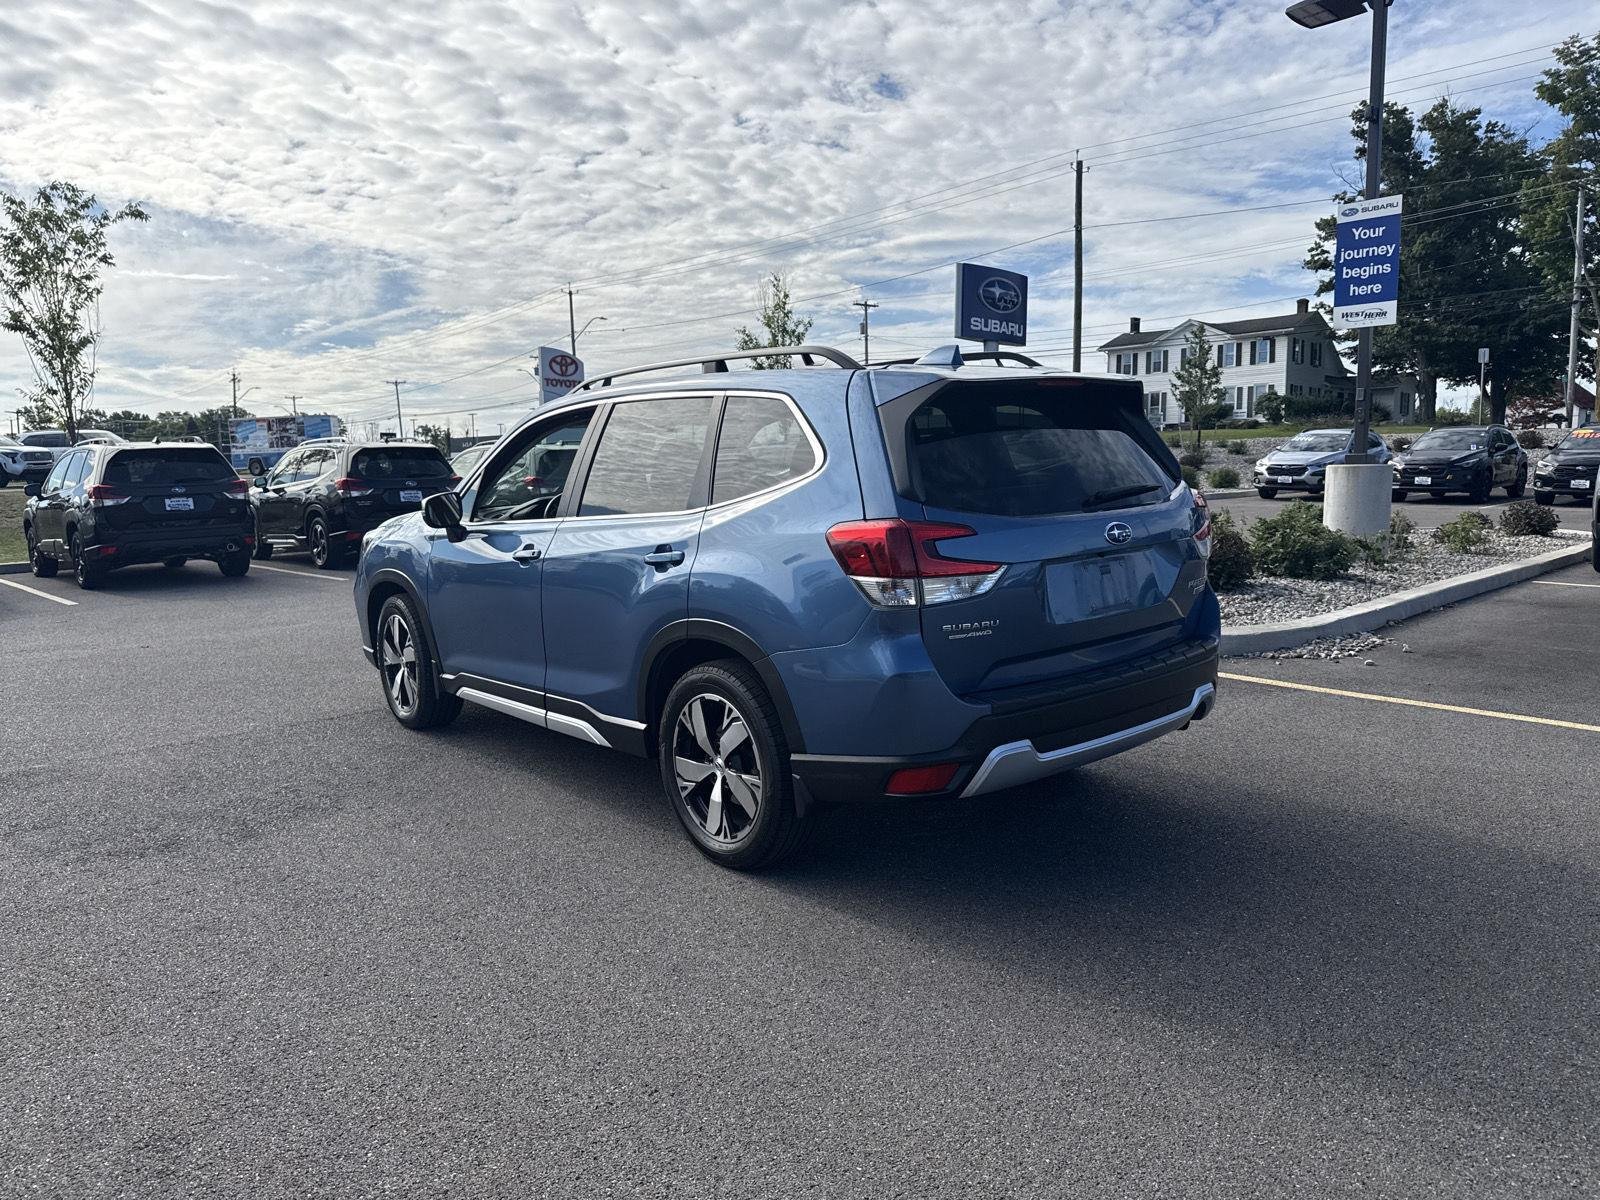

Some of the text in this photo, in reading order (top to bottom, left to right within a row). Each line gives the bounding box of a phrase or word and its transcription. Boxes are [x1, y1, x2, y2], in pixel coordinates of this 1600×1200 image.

[1361, 202, 1399, 213] SUBARU
[1352, 226, 1386, 240] Your
[1339, 244, 1396, 263] journey
[1342, 263, 1392, 279] begins
[1349, 283, 1382, 296] here
[970, 317, 1023, 337] SUBARU
[942, 620, 1000, 632] SUBARU
